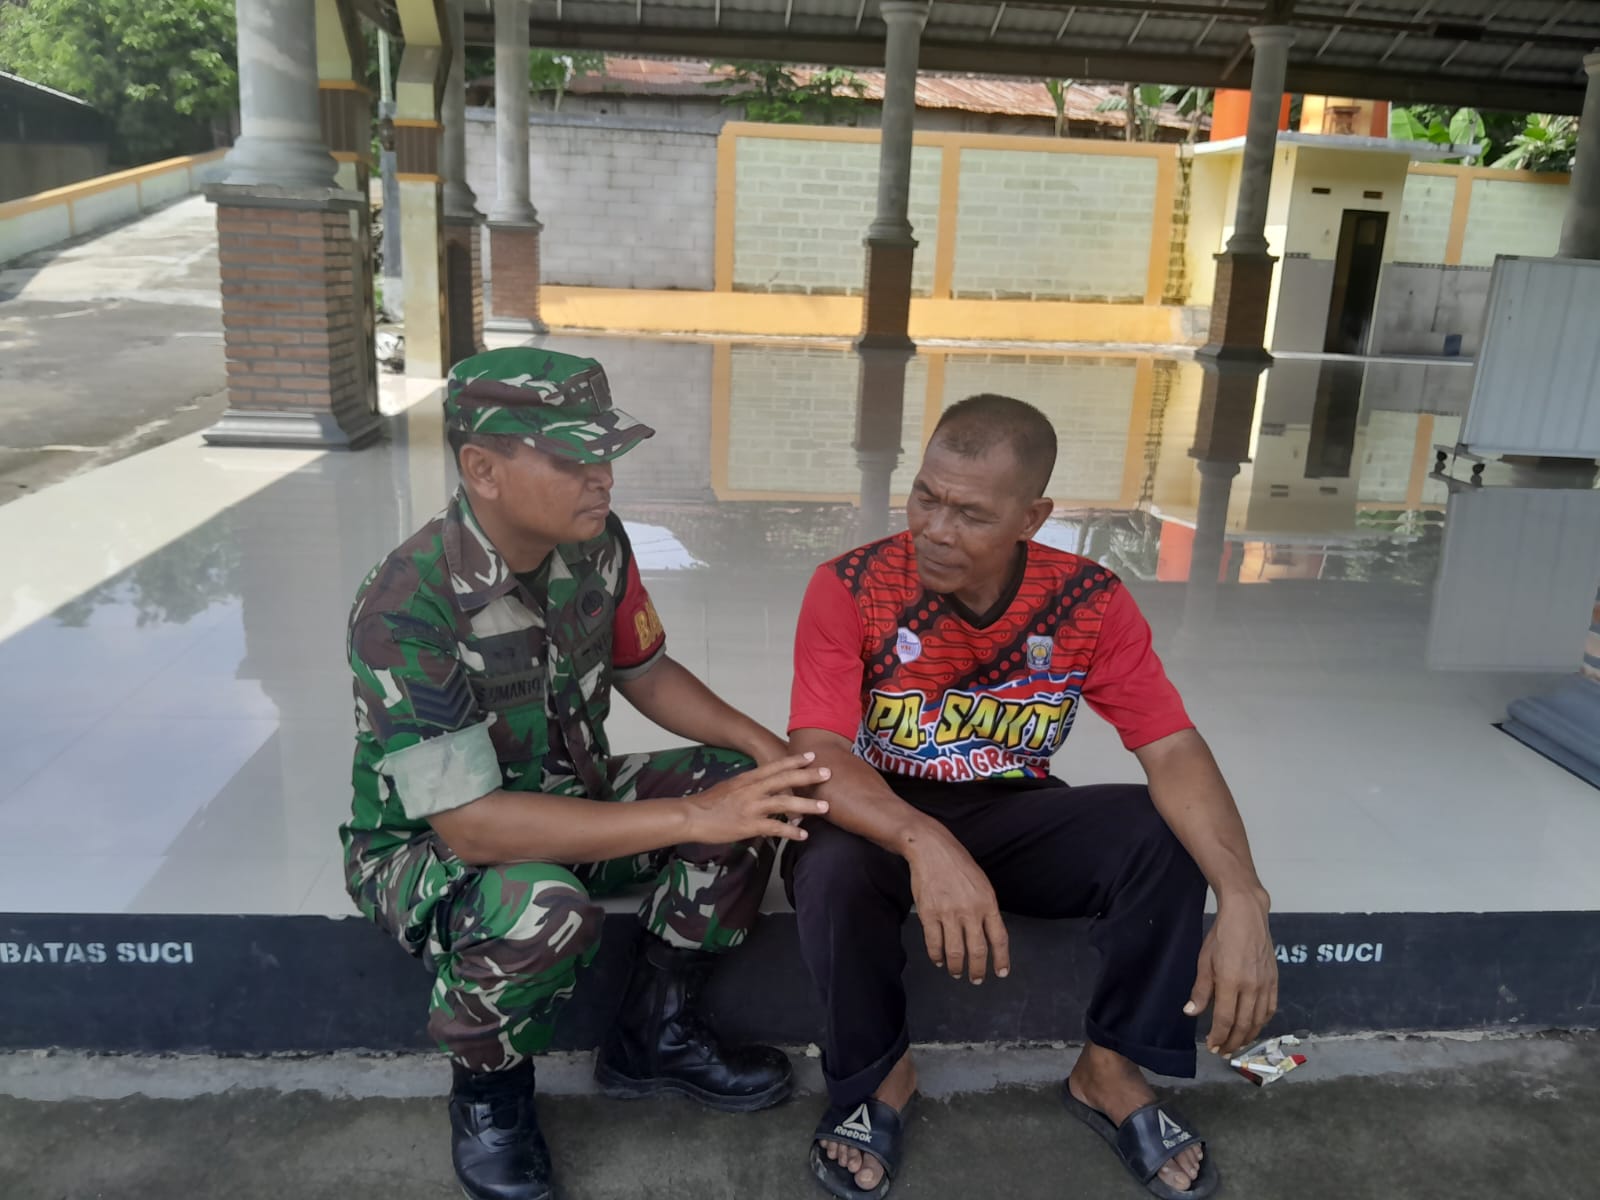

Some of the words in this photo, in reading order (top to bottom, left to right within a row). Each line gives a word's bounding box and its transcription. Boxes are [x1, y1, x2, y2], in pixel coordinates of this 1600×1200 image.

[867, 691, 927, 750] PB.
[866, 744, 973, 782] MUTIARA
[0, 942, 108, 963] BATAS
[116, 942, 194, 963] SUCI
[1274, 943, 1308, 963] AS
[1316, 943, 1383, 962] SUCI
[833, 1125, 872, 1143] Reebok
